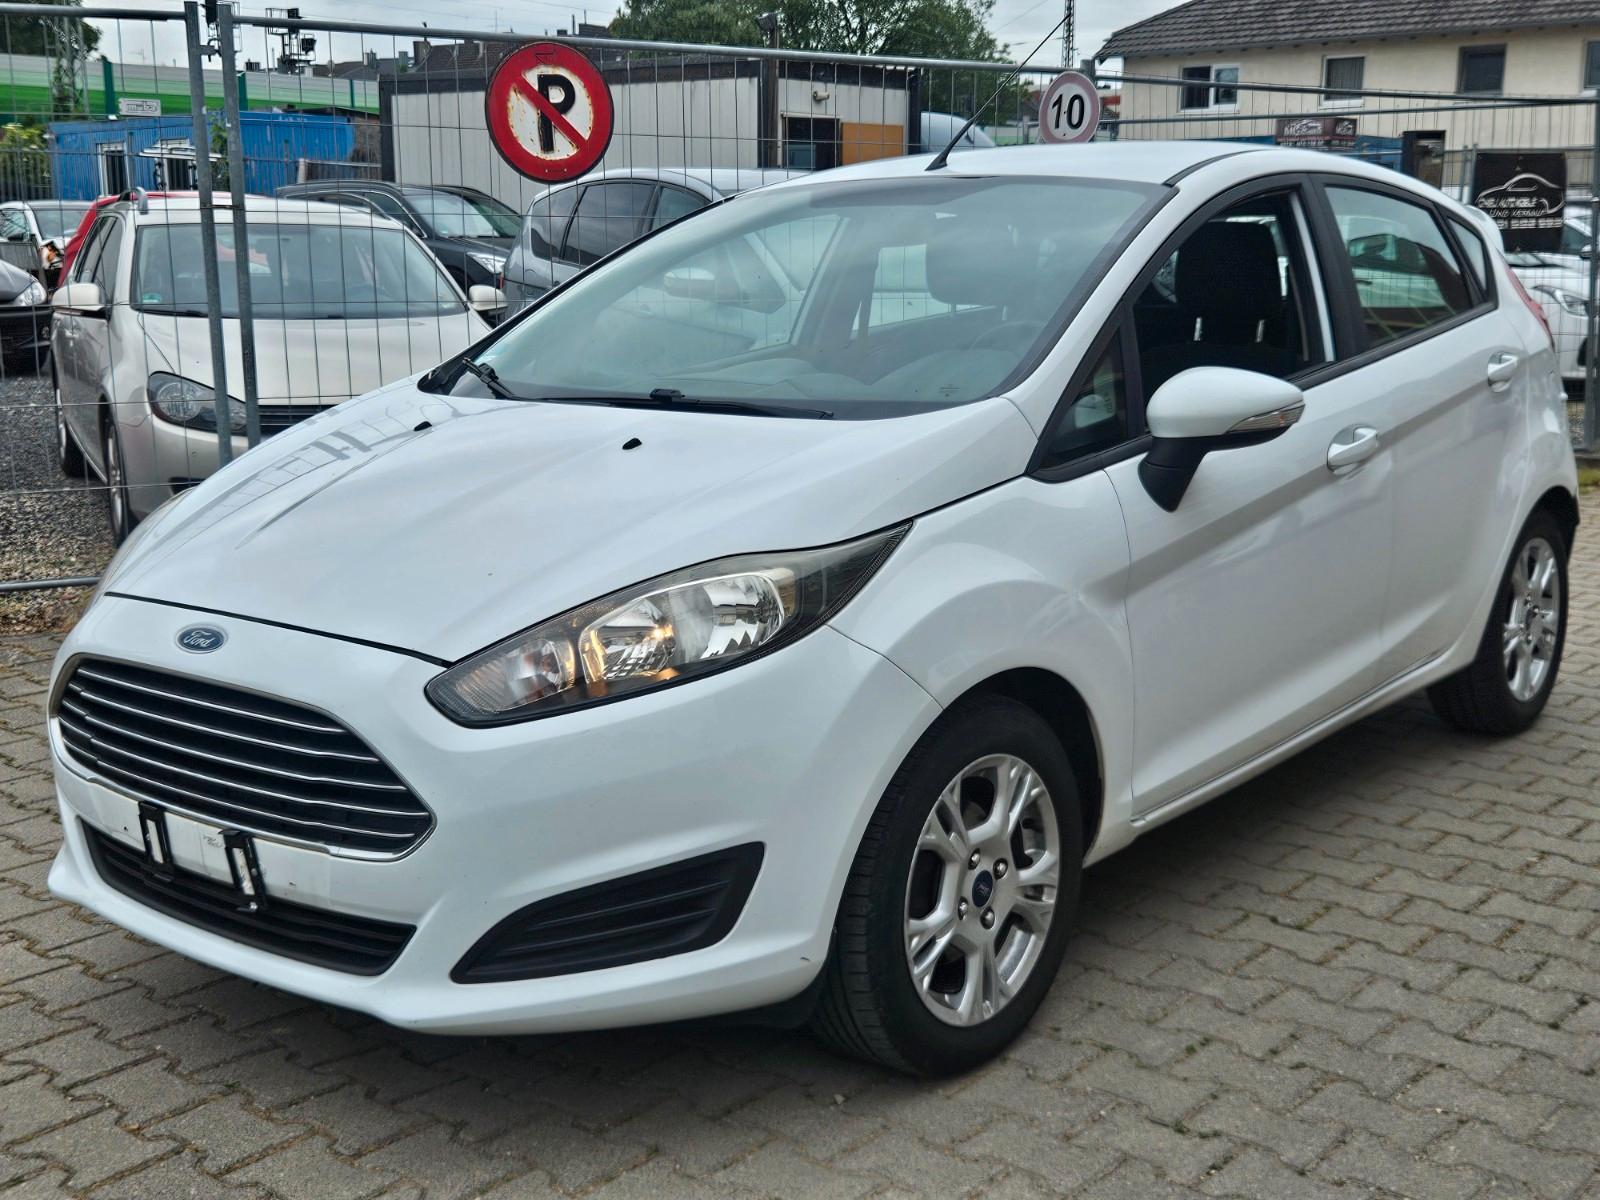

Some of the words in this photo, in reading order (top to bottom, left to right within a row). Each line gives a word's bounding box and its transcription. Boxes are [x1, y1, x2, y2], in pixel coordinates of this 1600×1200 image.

[537, 73, 575, 153] P
[1052, 94, 1085, 130] 10
[183, 630, 215, 647] Ford
